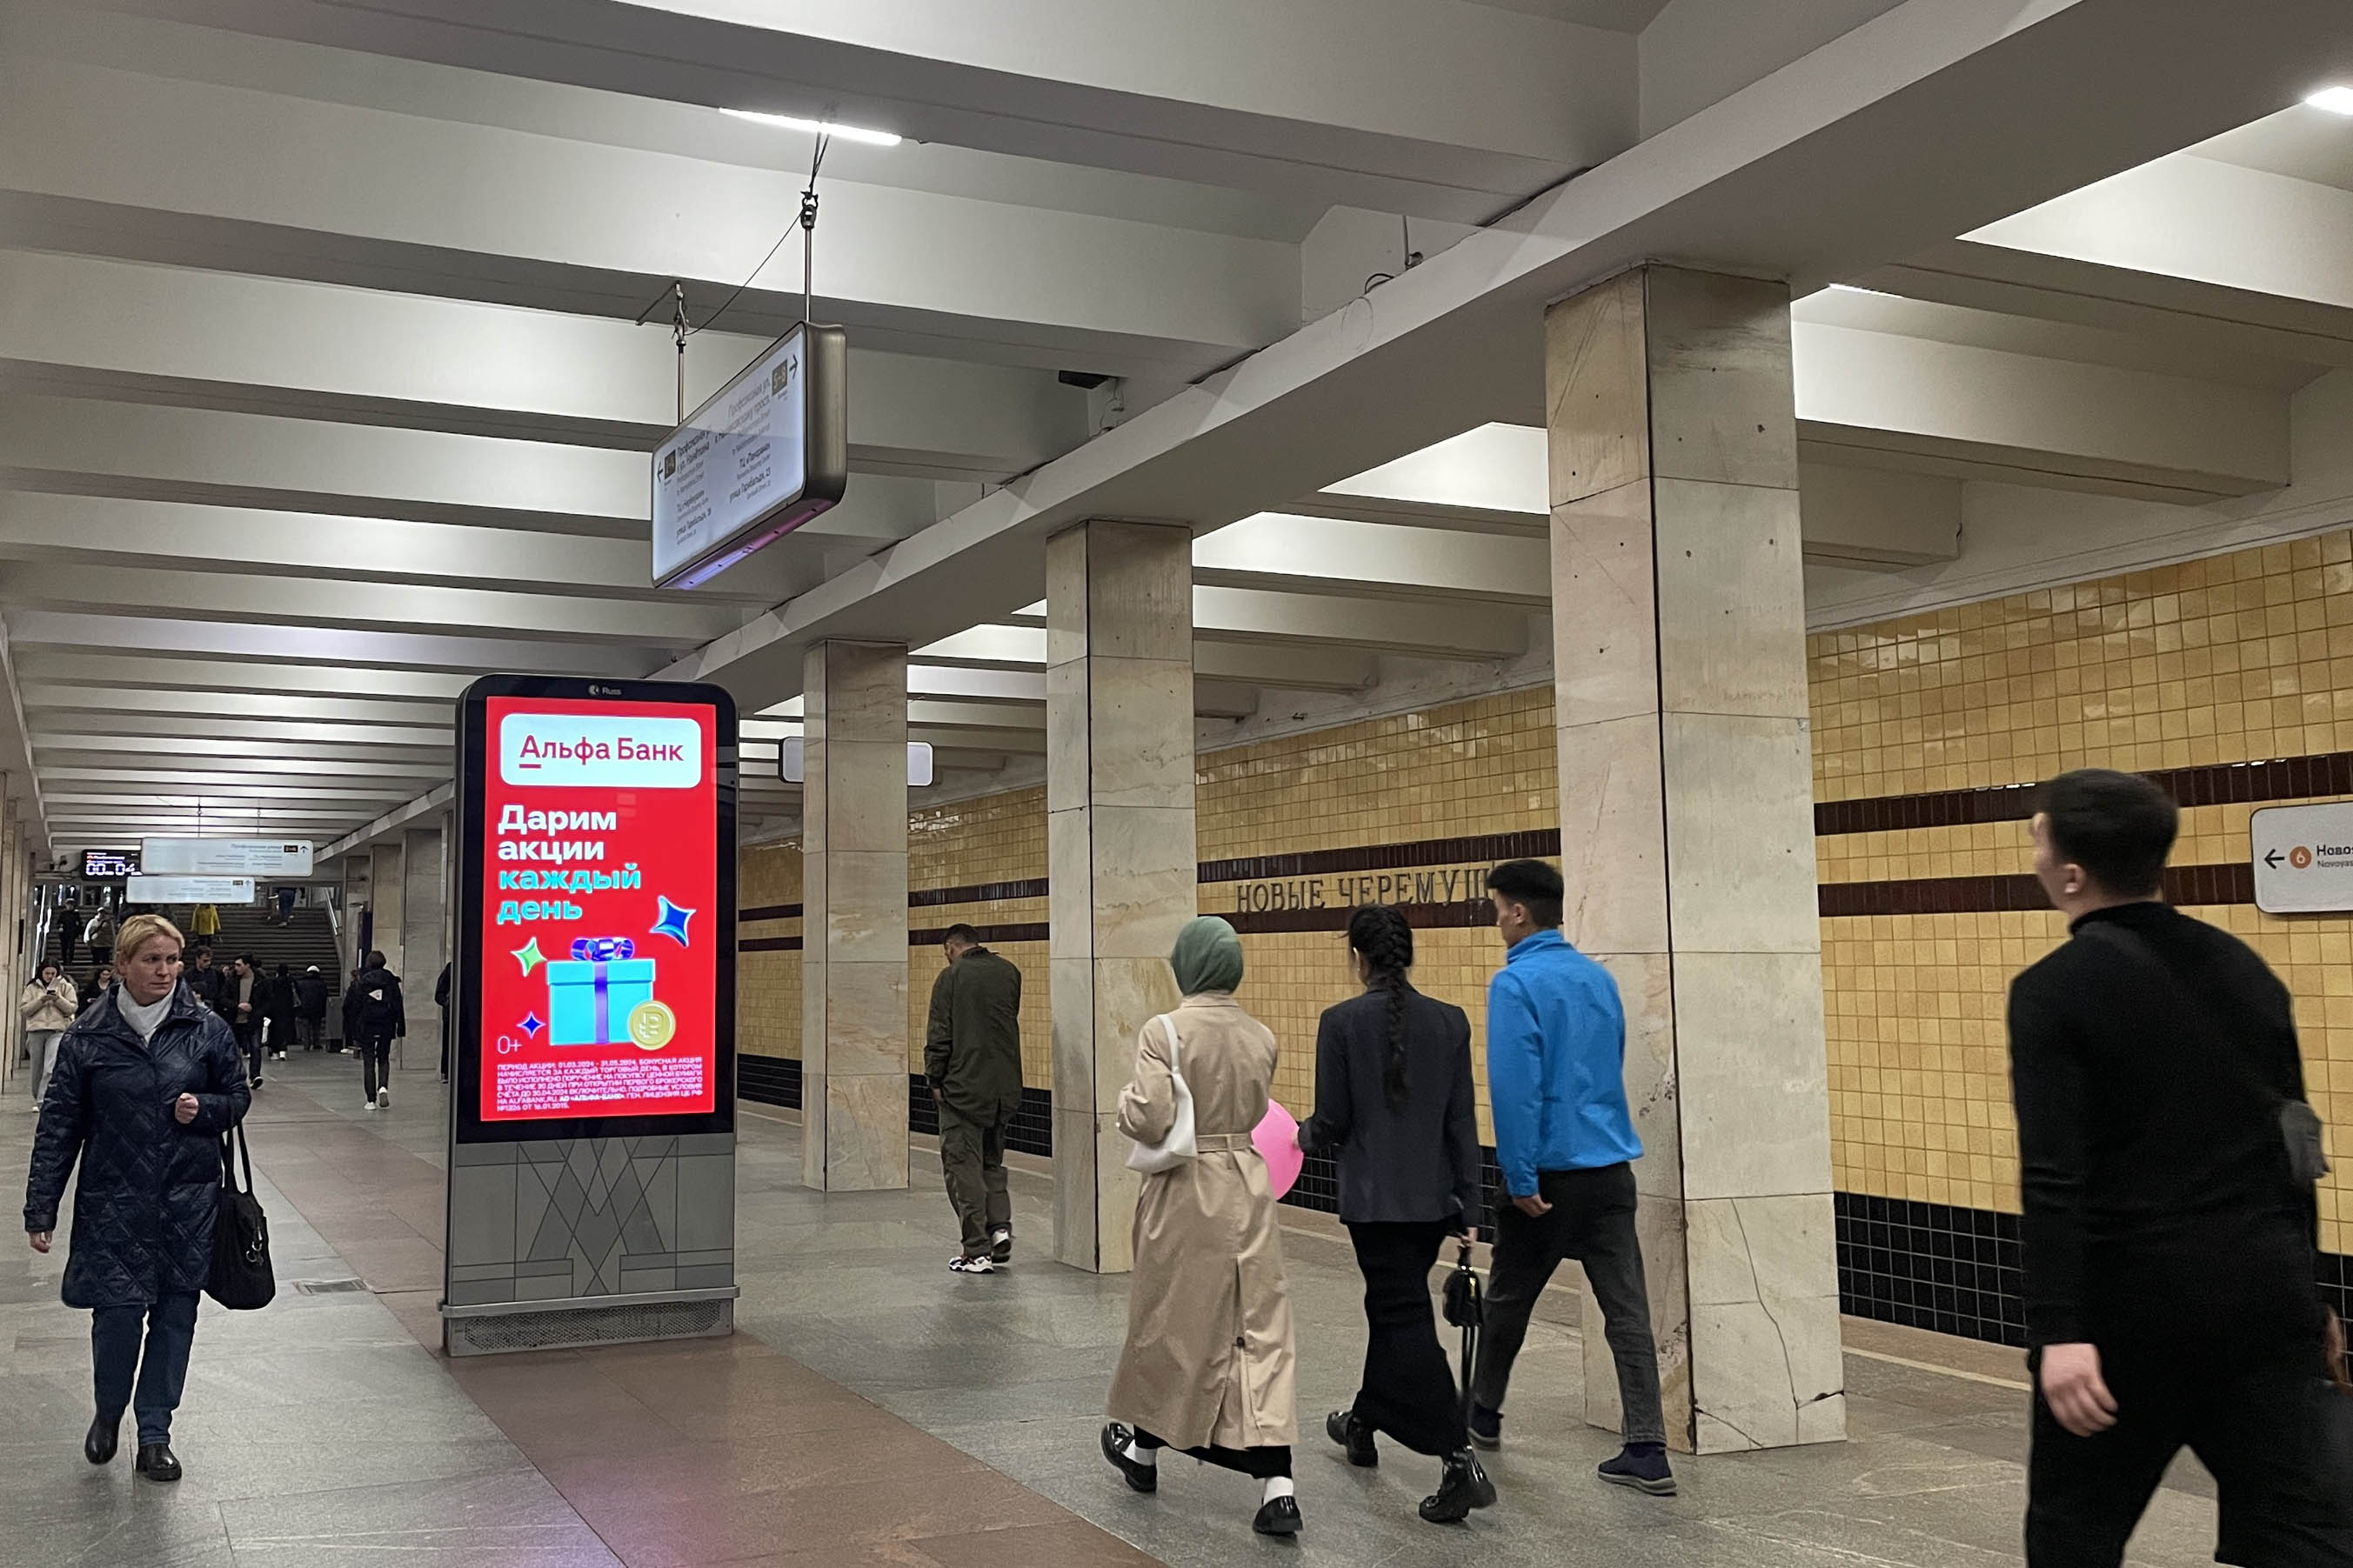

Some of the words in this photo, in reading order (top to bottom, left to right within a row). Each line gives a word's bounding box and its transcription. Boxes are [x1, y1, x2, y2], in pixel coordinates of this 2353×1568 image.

[519, 735, 611, 767] Альфа
[618, 737, 684, 762] Банк
[498, 804, 617, 837] Дарим
[498, 838, 605, 864] акции
[2316, 844, 2353, 857] Ново
[498, 863, 642, 894] каждый
[1236, 879, 1326, 913] НОВЫЕ
[1338, 868, 1492, 908] ЧЕРЕМУШ
[497, 899, 583, 925] день
[497, 1035, 523, 1055] 0+
